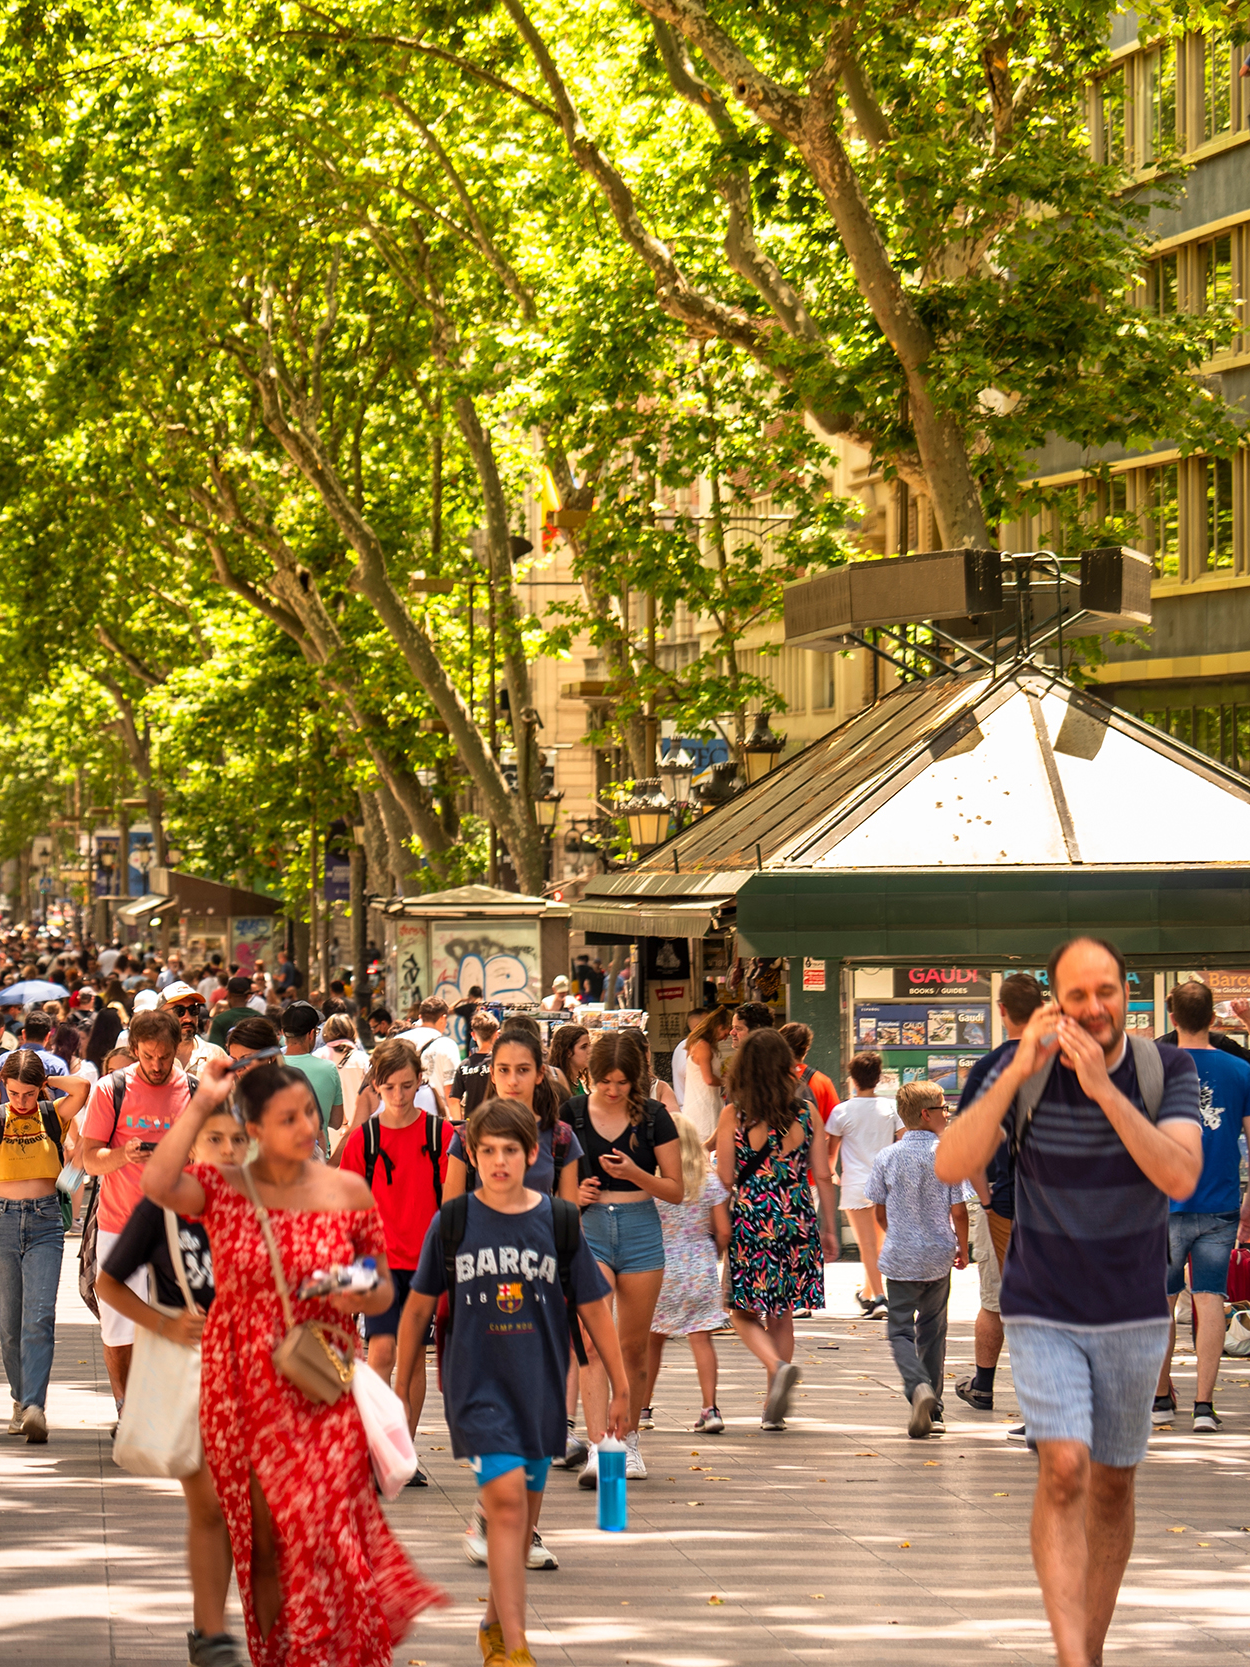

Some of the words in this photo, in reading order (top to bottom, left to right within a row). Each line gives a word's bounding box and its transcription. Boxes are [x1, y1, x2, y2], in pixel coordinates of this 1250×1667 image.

[455, 1246, 556, 1284] BARÇA
[489, 1322, 514, 1332] CAMP
[516, 1321, 533, 1331] NOU
